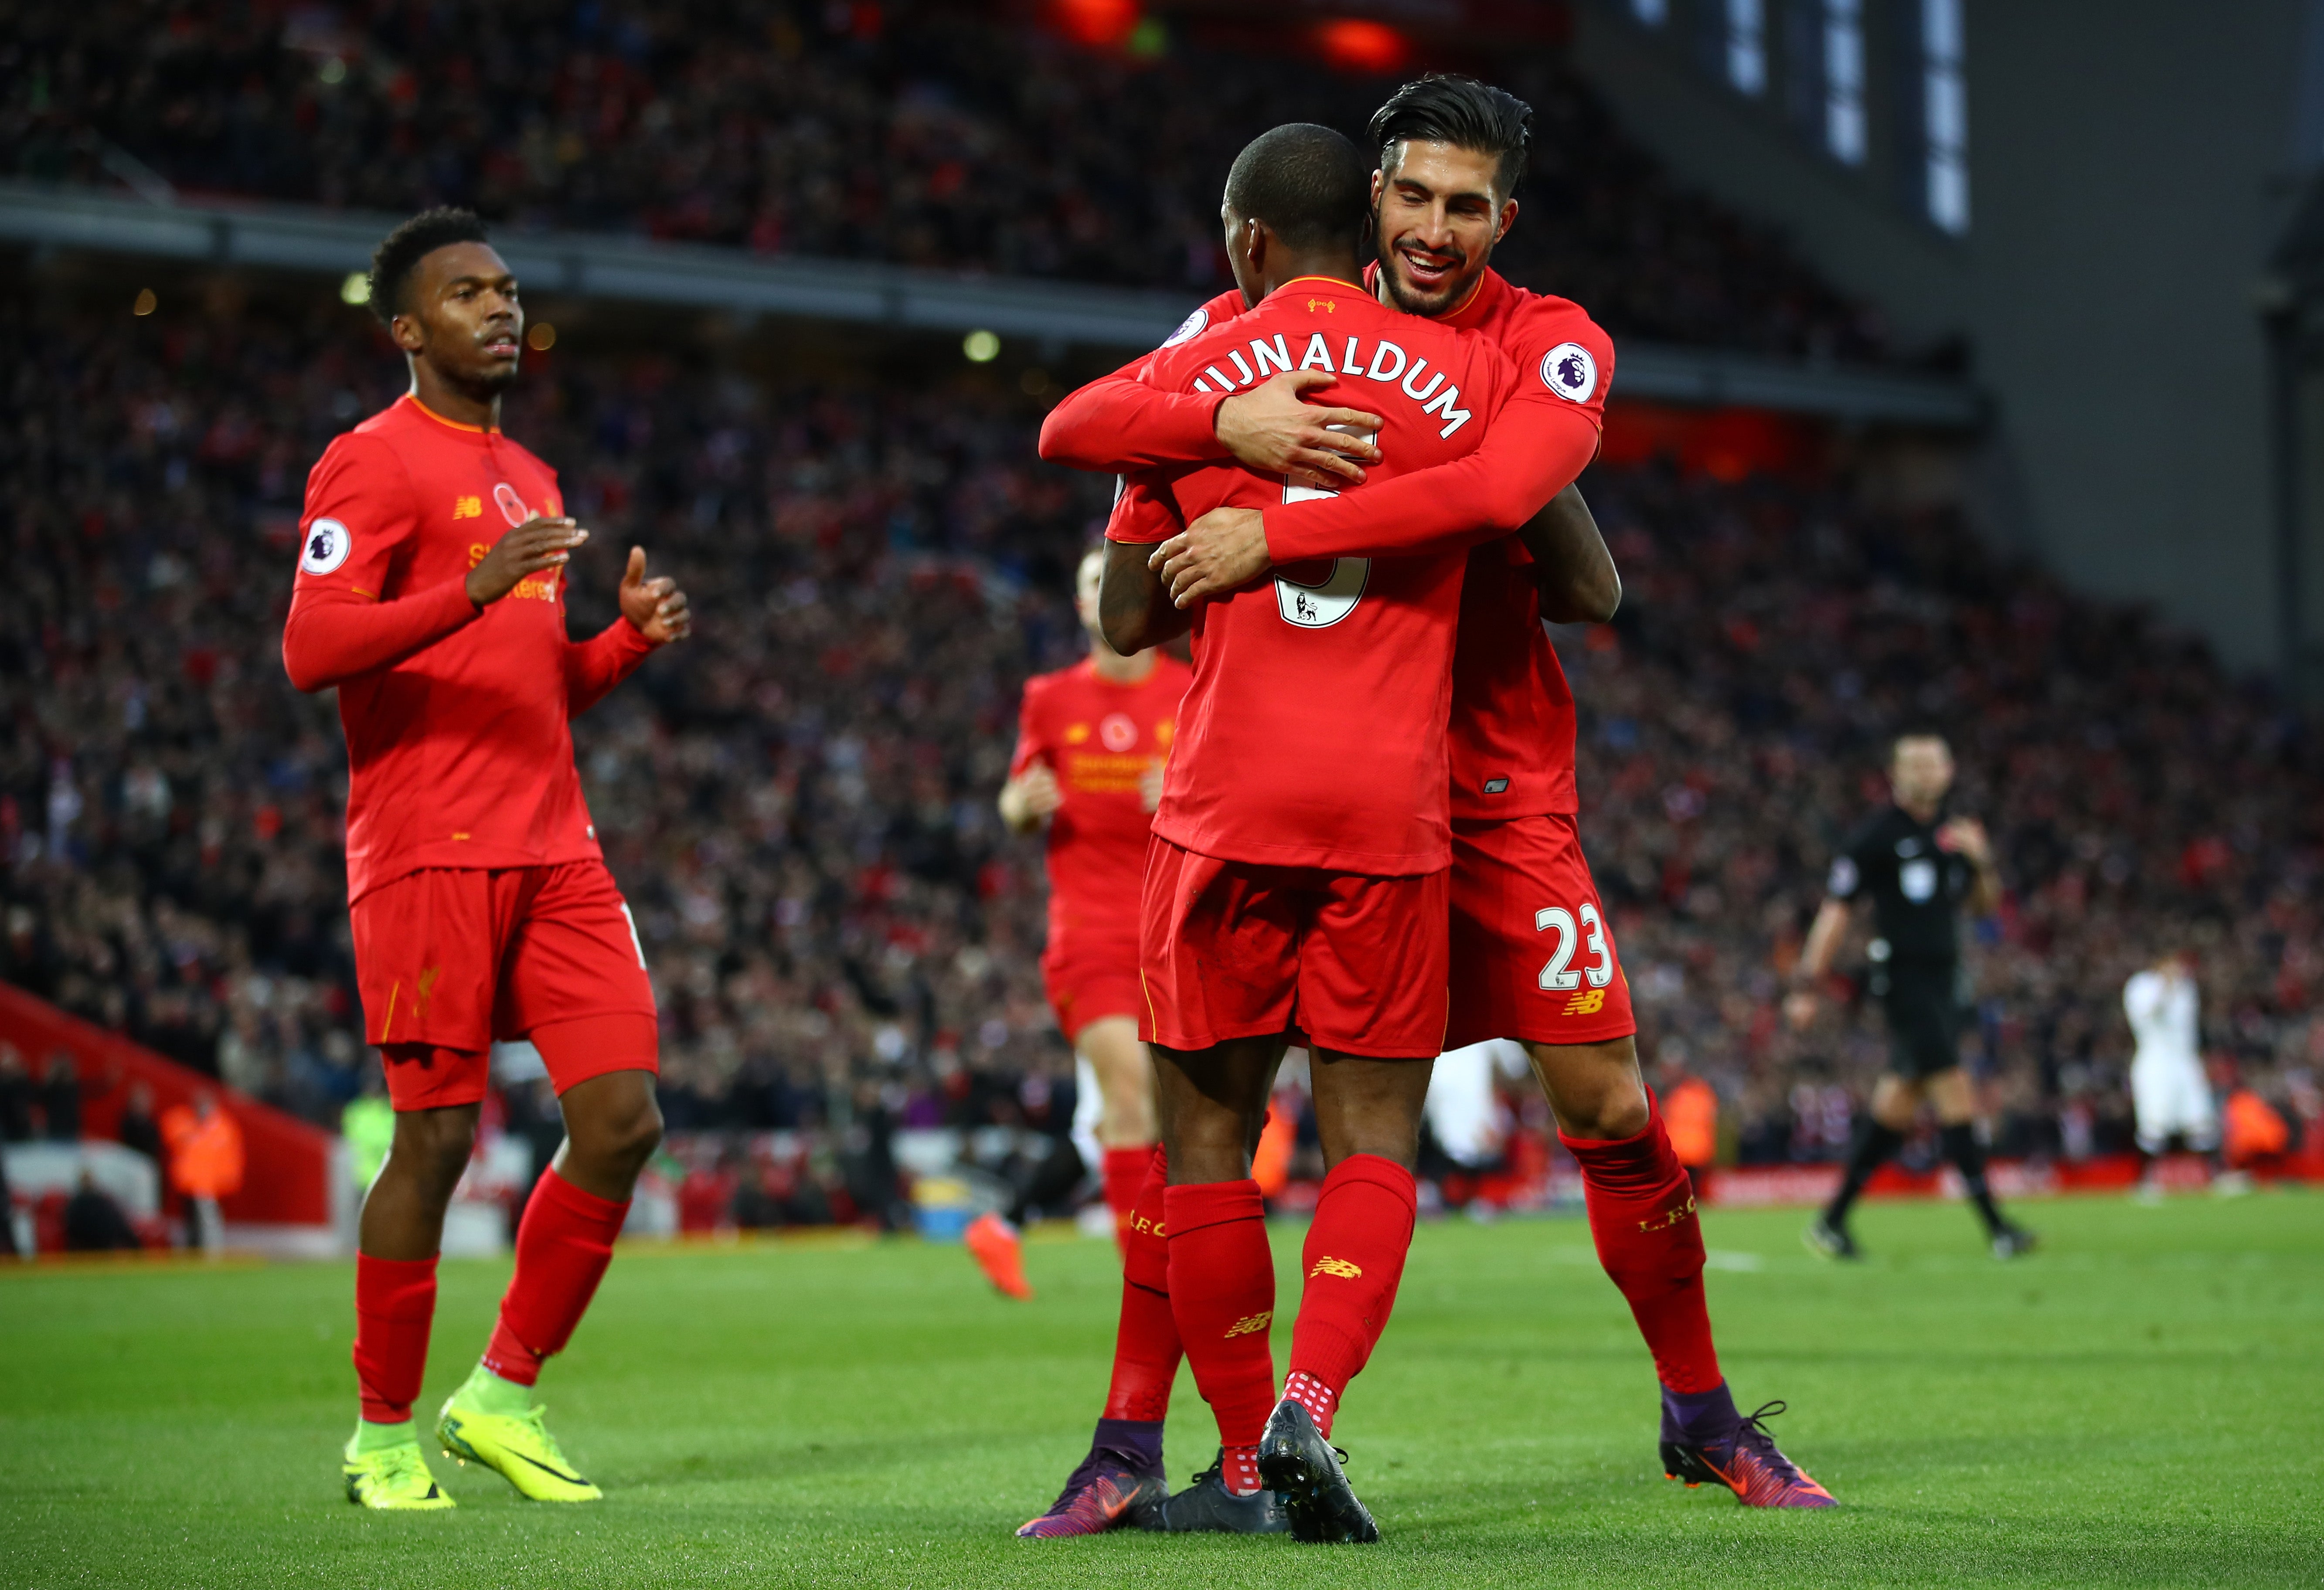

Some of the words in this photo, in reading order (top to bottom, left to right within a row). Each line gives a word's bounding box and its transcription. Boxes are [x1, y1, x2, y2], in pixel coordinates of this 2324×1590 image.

[1192, 333, 1472, 440] IJNALDUM
[1550, 378, 1566, 393] League
[1535, 903, 1613, 990] 23
[1562, 989, 1605, 1016] NB
